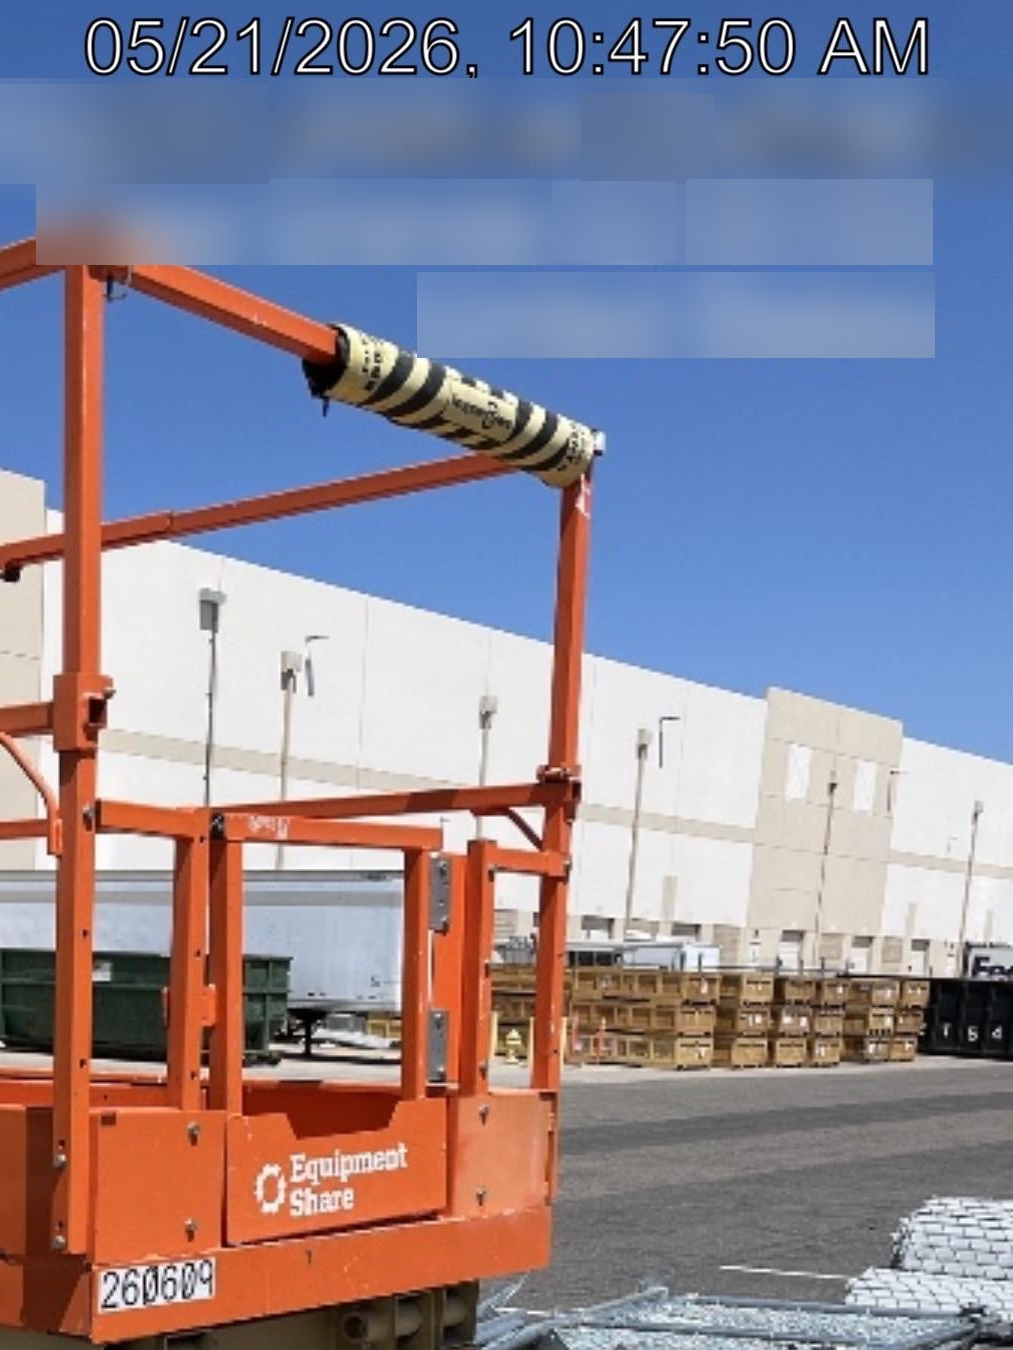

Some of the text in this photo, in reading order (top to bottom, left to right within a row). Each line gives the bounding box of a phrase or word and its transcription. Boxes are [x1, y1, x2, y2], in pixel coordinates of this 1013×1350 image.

[290, 1142, 408, 1186] Equipment
[290, 1187, 355, 1217] Share
[101, 1258, 214, 1309] 260609
